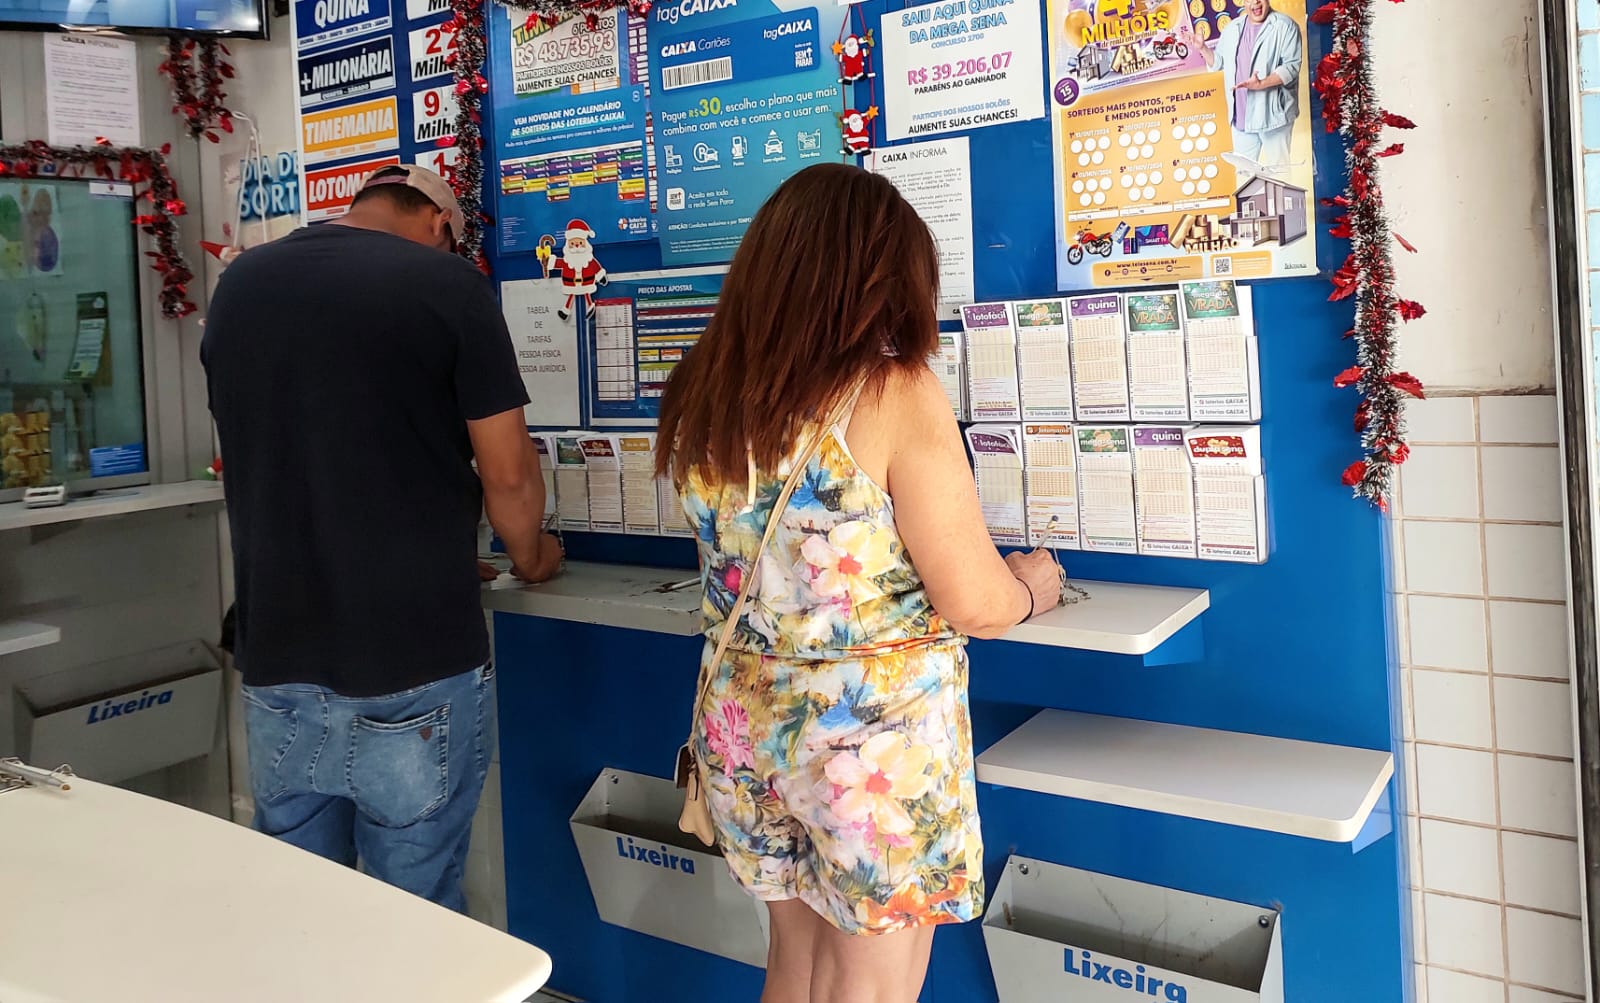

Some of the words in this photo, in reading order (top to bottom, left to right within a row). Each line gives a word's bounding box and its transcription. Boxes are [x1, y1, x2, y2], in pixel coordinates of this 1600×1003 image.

[902, 10, 931, 27] SAIU
[933, 1, 966, 22] AQUI
[968, 0, 1014, 13] QUI
[763, 19, 812, 40] tagCAIXA
[909, 29, 928, 45] DA
[929, 22, 968, 40] MEGA
[971, 12, 1008, 31] SENA
[1081, 11, 1169, 46] MILHÕES
[515, 44, 534, 68] R$
[538, 30, 615, 63] 48.735,93
[661, 41, 697, 57] CAIXA
[698, 36, 731, 51] Cartões
[301, 48, 391, 91] +MILIONÁRIA
[415, 55, 450, 78] Milh
[907, 67, 928, 85] R$
[932, 51, 1013, 81] 39.206,07
[516, 80, 552, 92] AUMENTE
[554, 74, 575, 85] SUAS
[577, 67, 617, 81] CHANCES!
[914, 80, 951, 95] PARABÉNS
[952, 79, 963, 88] AO
[964, 72, 1007, 86] GANHADOR
[1060, 84, 1073, 97] 15
[528, 111, 561, 124] NOVIDADE
[563, 108, 576, 117] NO
[576, 101, 621, 116] CALENDÁRIO
[661, 111, 687, 123] Pague
[725, 98, 758, 113] escolha
[768, 93, 794, 108] plano
[796, 92, 813, 102] que
[816, 86, 838, 98] mais
[1067, 106, 1105, 119] SORTEIOS
[1107, 102, 1127, 113] MAIS
[1105, 114, 1110, 122] E
[1112, 110, 1141, 121] MENOS
[1142, 105, 1177, 117] PONTOS
[304, 107, 394, 145] TIMEMANIA
[551, 120, 565, 131] DAS
[662, 121, 697, 136] combina
[700, 120, 717, 131] com
[720, 114, 739, 128] você
[749, 112, 781, 124] comece
[793, 106, 812, 117] usar
[908, 122, 947, 134] AUMENTE
[949, 117, 972, 128] SUAS
[973, 108, 1018, 123] CHANCES!
[882, 152, 908, 164] CAIXA
[909, 147, 947, 160] INFORMA
[240, 181, 298, 217] SORT
[1185, 235, 1240, 255] MILHÃO
[667, 284, 693, 293] APOSTAS
[527, 306, 549, 314] TABELA
[973, 309, 1007, 321] lotofácil
[1088, 300, 1116, 310] quina
[1189, 298, 1234, 311] VIRADA
[1133, 311, 1176, 323] VIRADA
[519, 365, 537, 373] ESSOA
[1152, 431, 1181, 443] quina
[86, 690, 173, 725] Lixeira
[616, 837, 695, 875] Lixeira
[1063, 948, 1187, 1003] Lixeira
